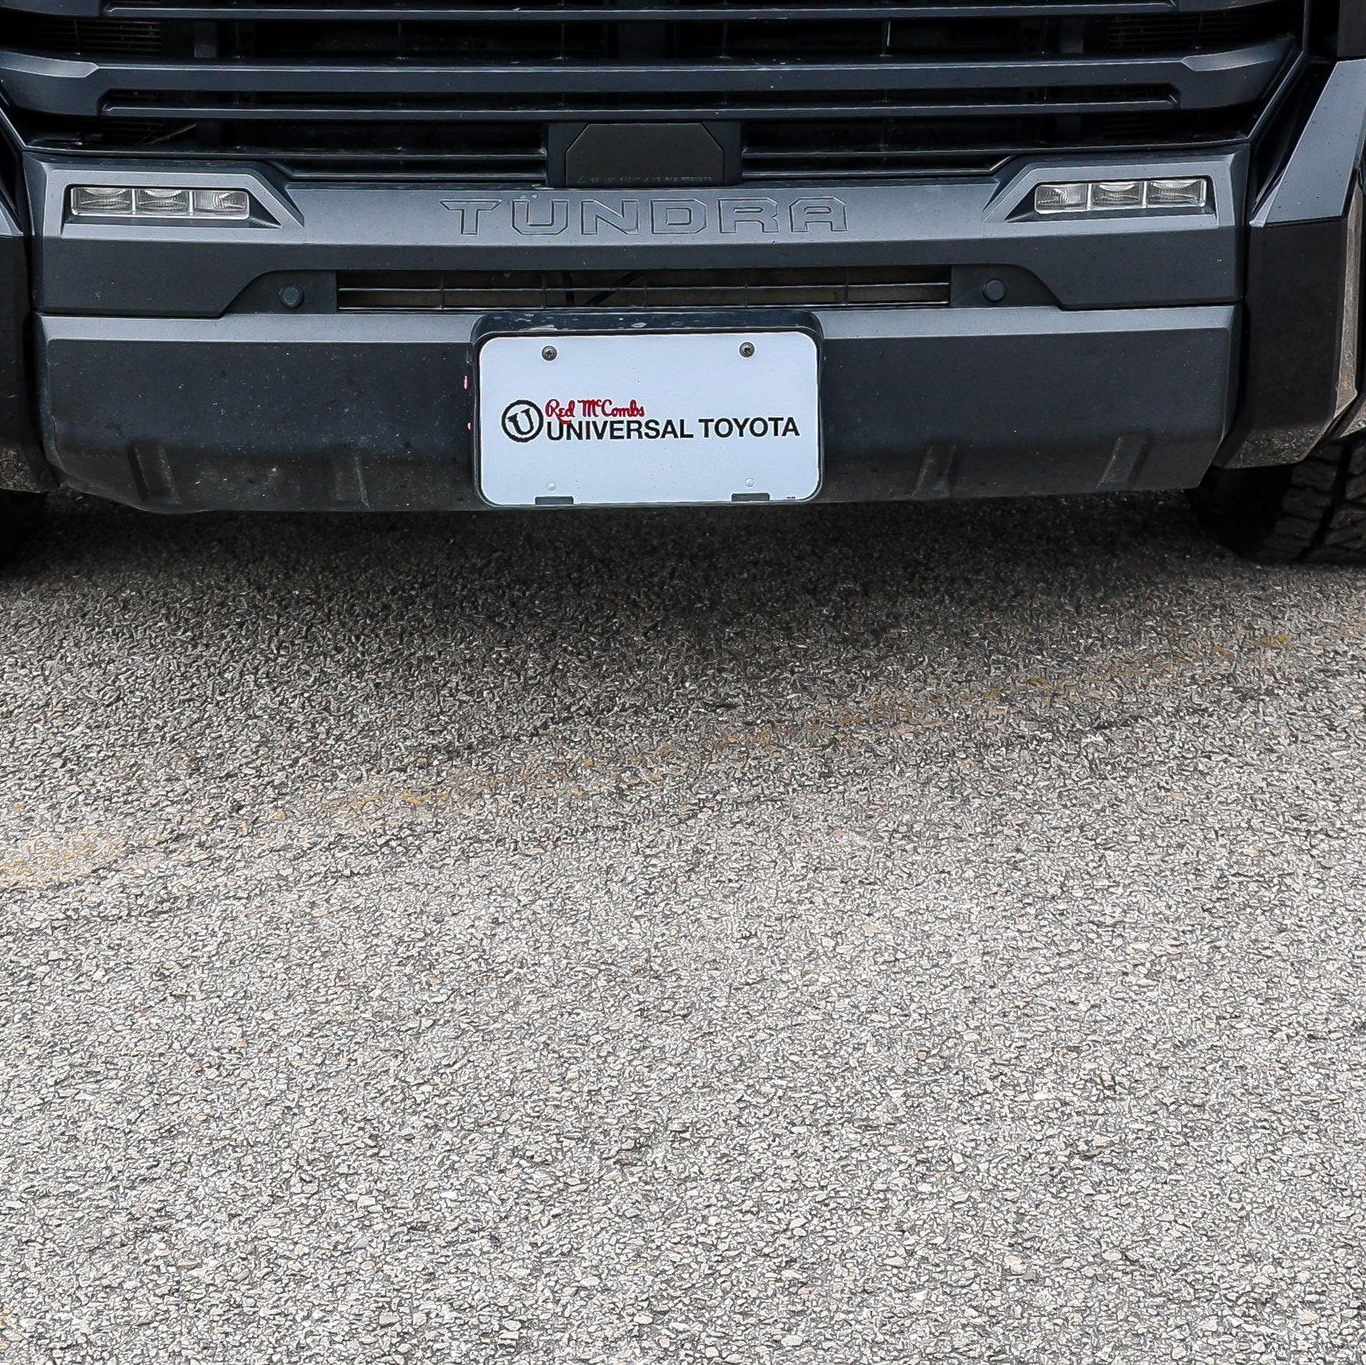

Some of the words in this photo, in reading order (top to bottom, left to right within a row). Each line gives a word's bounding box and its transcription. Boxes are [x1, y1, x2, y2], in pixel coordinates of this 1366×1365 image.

[439, 197, 849, 235] TUNDRA
[545, 399, 575, 424] Red
[578, 399, 646, 418] McCombs
[546, 418, 694, 441] UNIVERSAL
[698, 416, 801, 439] TOYOTA
